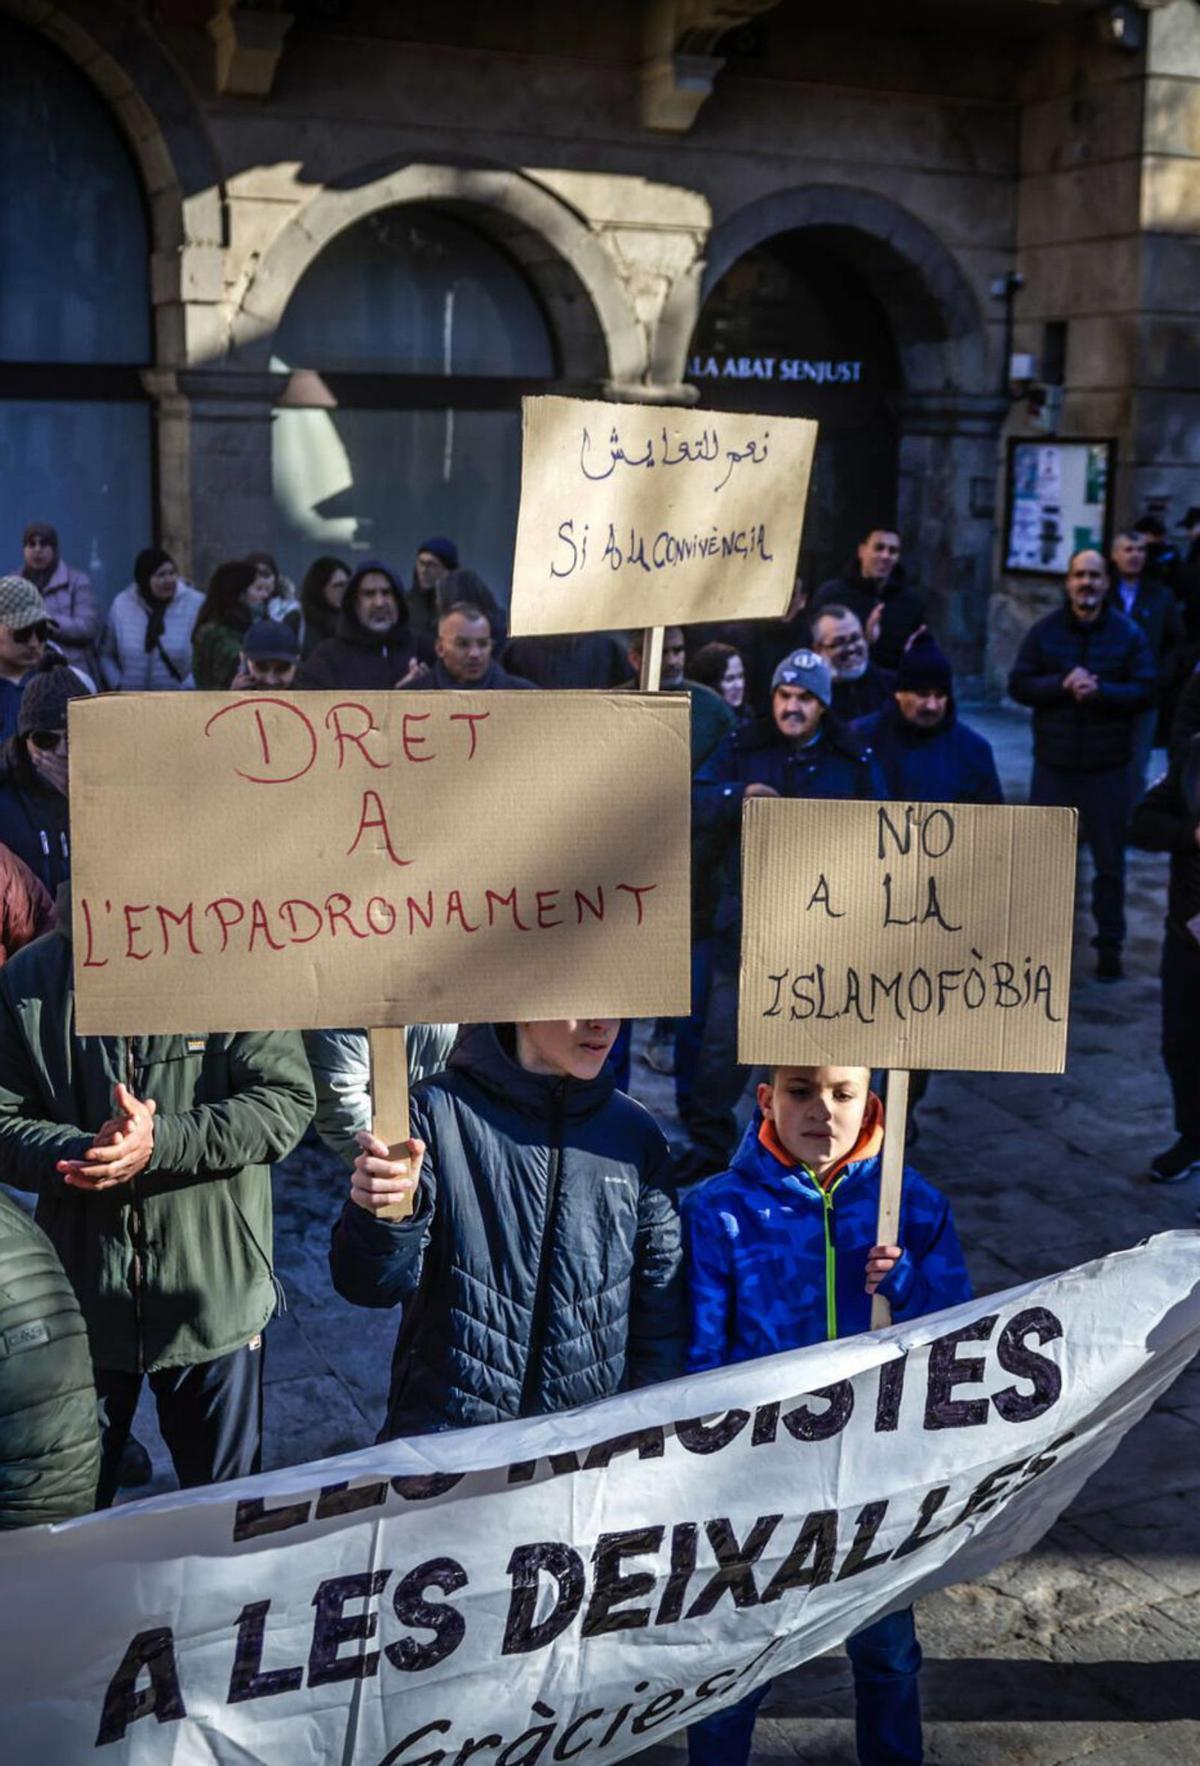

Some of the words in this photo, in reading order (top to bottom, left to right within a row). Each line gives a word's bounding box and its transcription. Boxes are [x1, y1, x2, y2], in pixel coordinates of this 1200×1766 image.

[722, 357, 775, 380] ABAT
[779, 359, 862, 384] SENJUST
[713, 429, 769, 492] نعم
[601, 522, 623, 571] A
[205, 698, 490, 783] DRET
[346, 790, 414, 866] A
[877, 805, 955, 860] NO
[82, 883, 657, 967] L'EMPADRONAMENT
[806, 873, 845, 918] A
[882, 872, 963, 932] LA
[95, 1626, 187, 1747] A
[226, 1556, 469, 1704] LES
[502, 1431, 1076, 1656] DEIXALLES
